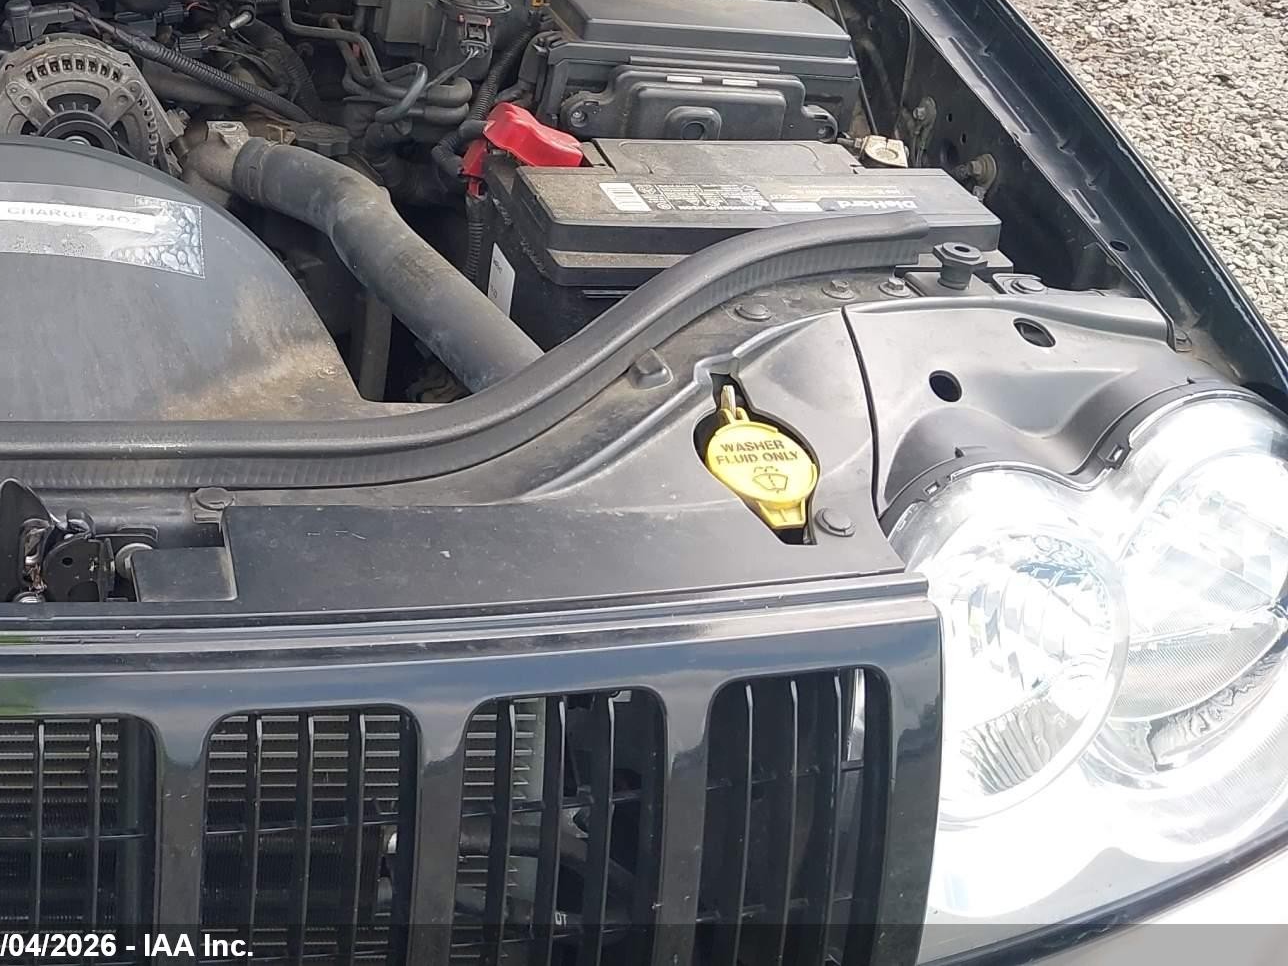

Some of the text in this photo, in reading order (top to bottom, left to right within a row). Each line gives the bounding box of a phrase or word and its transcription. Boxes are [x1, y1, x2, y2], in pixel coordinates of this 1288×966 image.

[837, 200, 918, 210] DieHard
[7, 206, 89, 219] CHARGE
[720, 439, 785, 452] WASHER
[716, 450, 799, 465] FLUID ONLY
